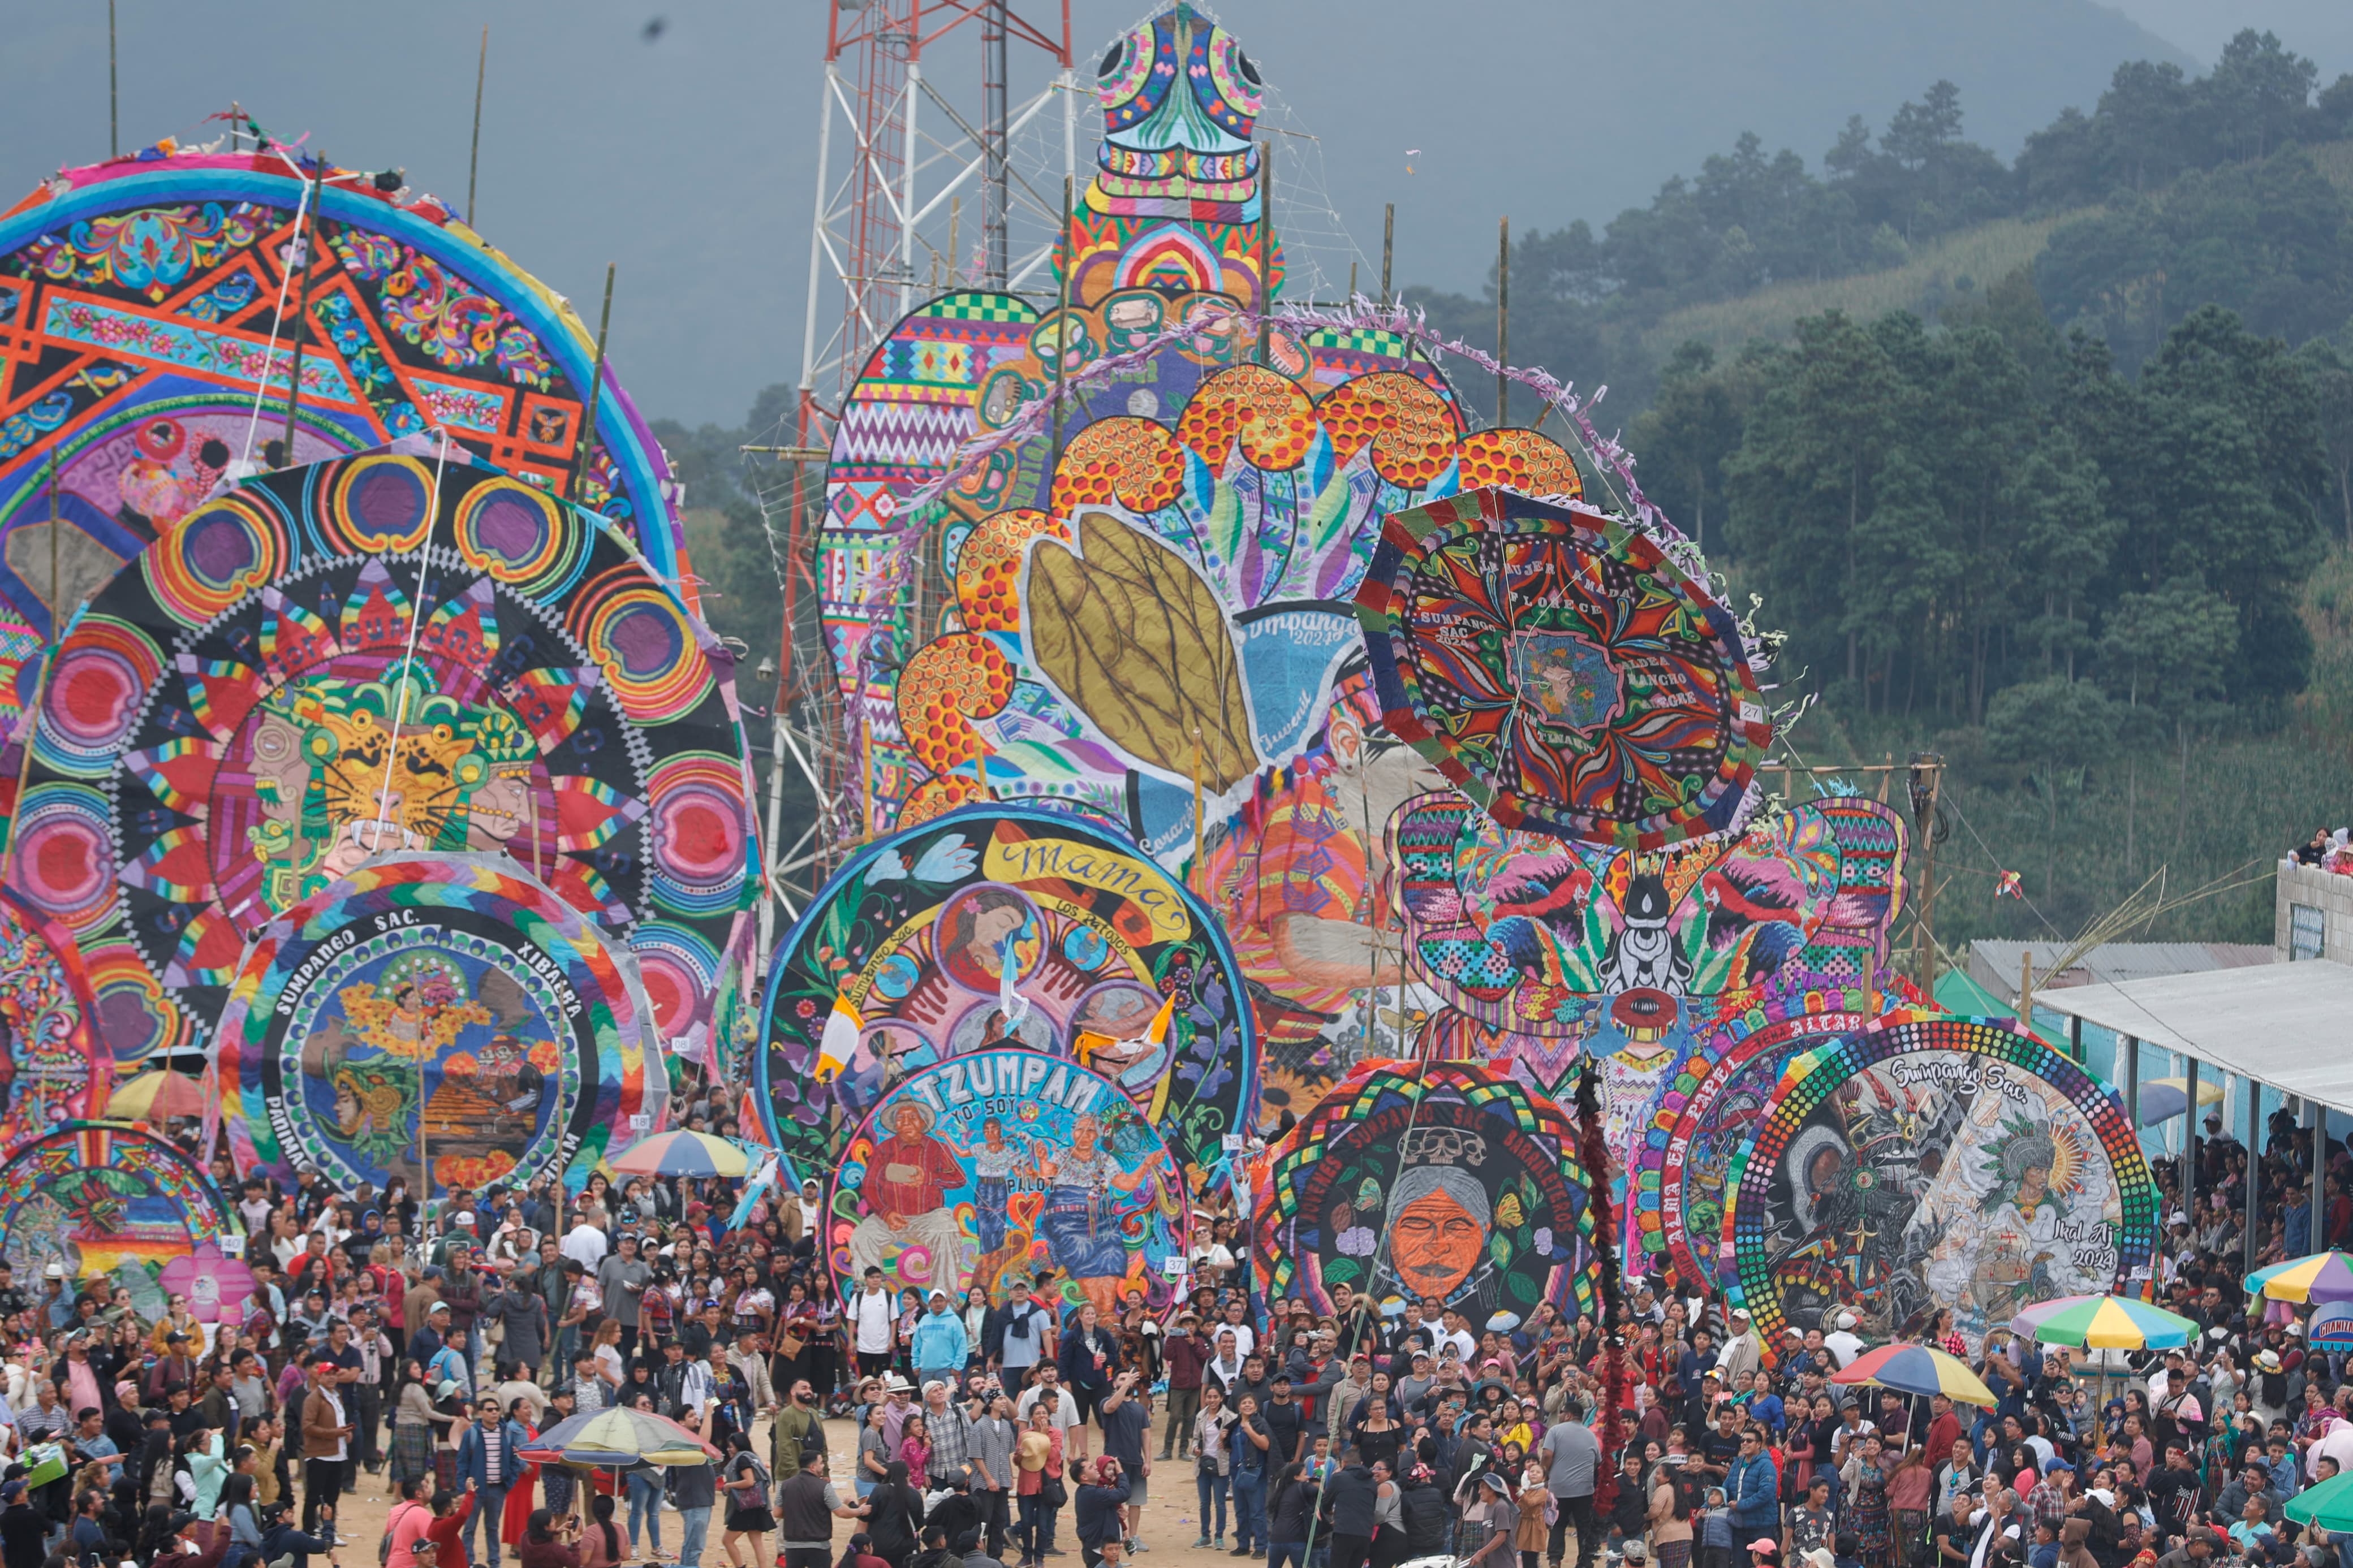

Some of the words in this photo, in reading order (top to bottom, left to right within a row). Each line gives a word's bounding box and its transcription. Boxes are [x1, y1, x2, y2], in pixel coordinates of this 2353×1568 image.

[1505, 561, 1555, 575] MUJER
[1572, 569, 1631, 598] AMADA
[1510, 591, 1602, 614] FLORECE
[1420, 611, 1497, 633] SUMPANGO
[1439, 626, 1469, 639] SAC
[1293, 629, 1333, 646] 2024
[1435, 634, 1471, 647] 2024
[1622, 656, 1670, 669] ALDEA
[1259, 687, 1312, 753] Juvenil
[1744, 706, 1759, 718] 27
[275, 928, 356, 1016] SUMPANGO
[374, 908, 421, 931] SAC.
[911, 1055, 1101, 1113] TZUMPAM
[1891, 1059, 1981, 1095] Sumpango
[1986, 1065, 2027, 1104] Sac.
[951, 1109, 973, 1124] YO
[985, 1098, 1017, 1116] SOY
[633, 1117, 645, 1128] 18
[1664, 1181, 1685, 1244] ALMA
[1686, 1056, 1743, 1121] PAPEL
[1790, 1012, 1861, 1038] ALTAR
[1302, 1154, 1343, 1224] JOVENES
[1347, 1104, 1435, 1149] SUMPANGO
[1453, 1106, 1486, 1130] SAC
[1502, 1128, 1574, 1233] BARRILETEROS
[1006, 1177, 1057, 1194] PALOT
[1169, 1259, 1183, 1270] 37
[2072, 1249, 2115, 1269] 2024
